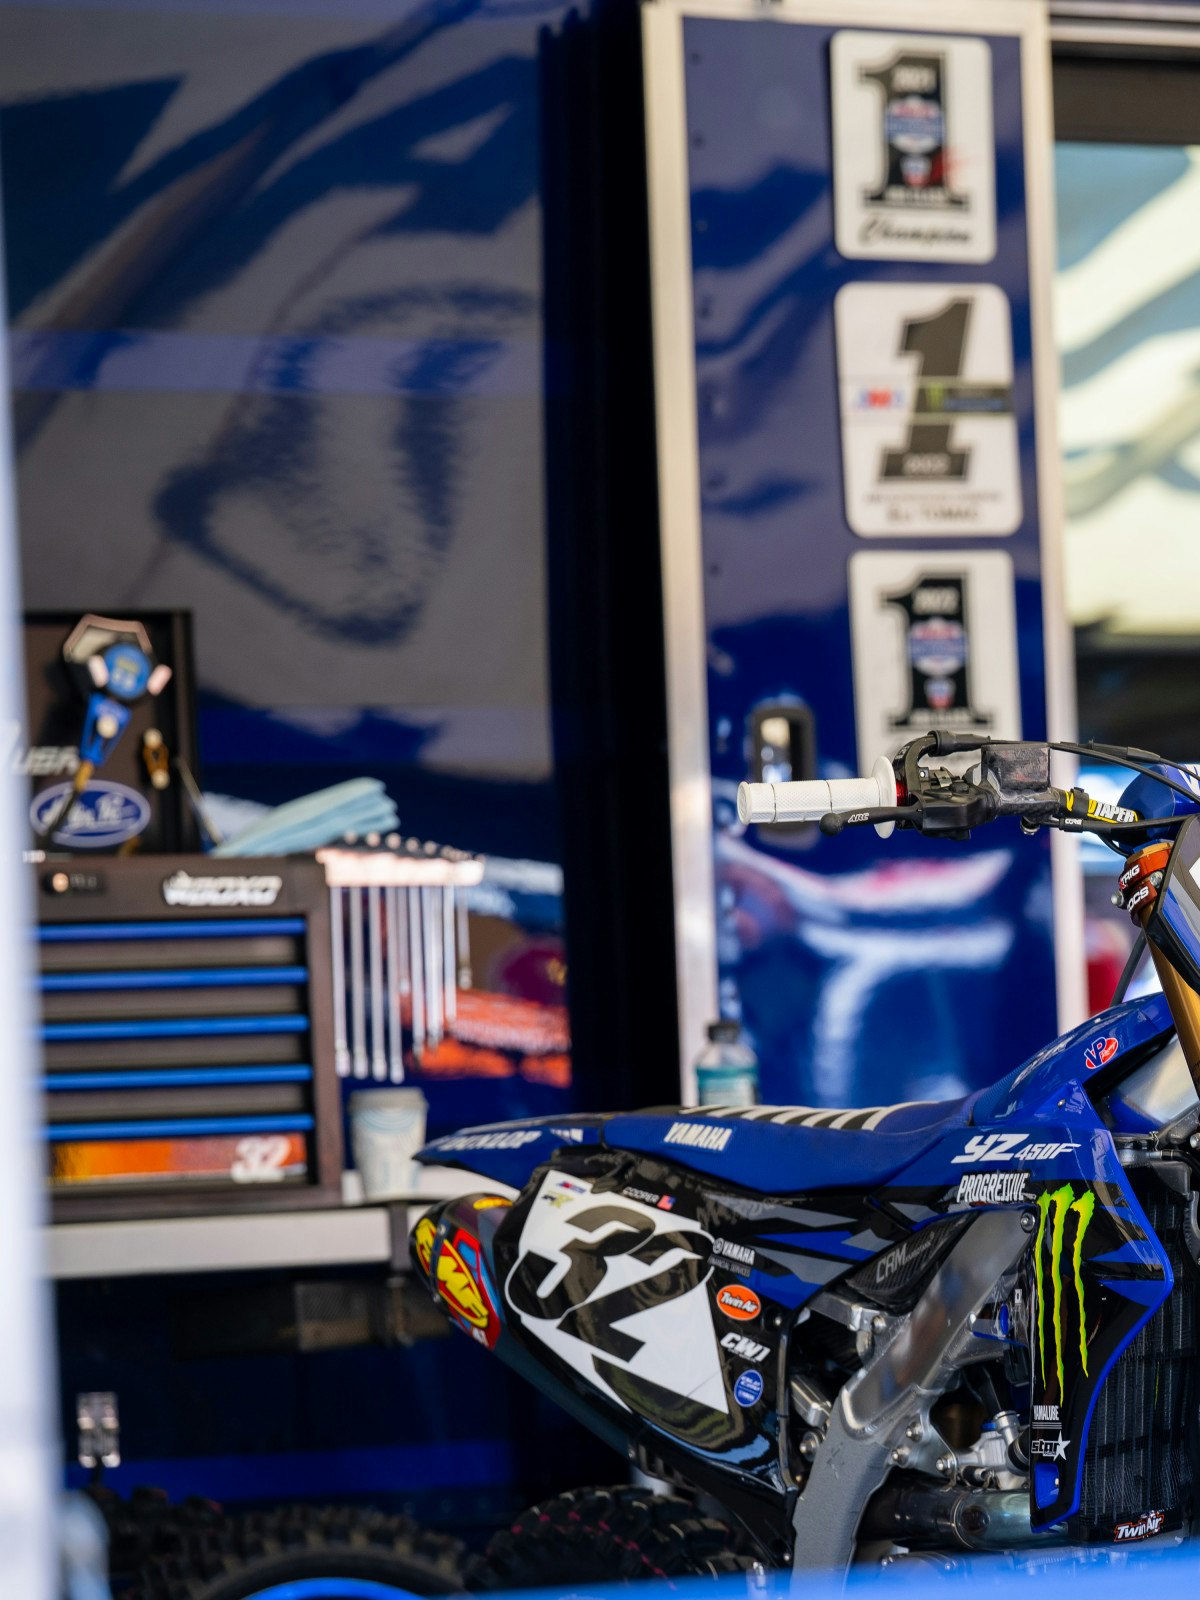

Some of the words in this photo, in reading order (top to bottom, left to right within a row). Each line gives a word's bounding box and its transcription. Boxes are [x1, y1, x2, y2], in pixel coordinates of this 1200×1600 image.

[857, 50, 972, 209] 1
[879, 297, 976, 483] 1
[878, 570, 994, 733] 1
[664, 1122, 733, 1151] YAMAHA
[230, 1136, 293, 1182] 32
[1014, 1143, 1082, 1161] 450F
[622, 1187, 660, 1204] COOPER
[956, 1172, 1029, 1203] PROGRESSIVE
[721, 1240, 756, 1266] YAMAHA
[506, 1203, 714, 1362] 32
[720, 1291, 745, 1306] Twin
[741, 1299, 759, 1313] Air
[1116, 1521, 1146, 1539] Twin
[1146, 1516, 1163, 1533] Air
